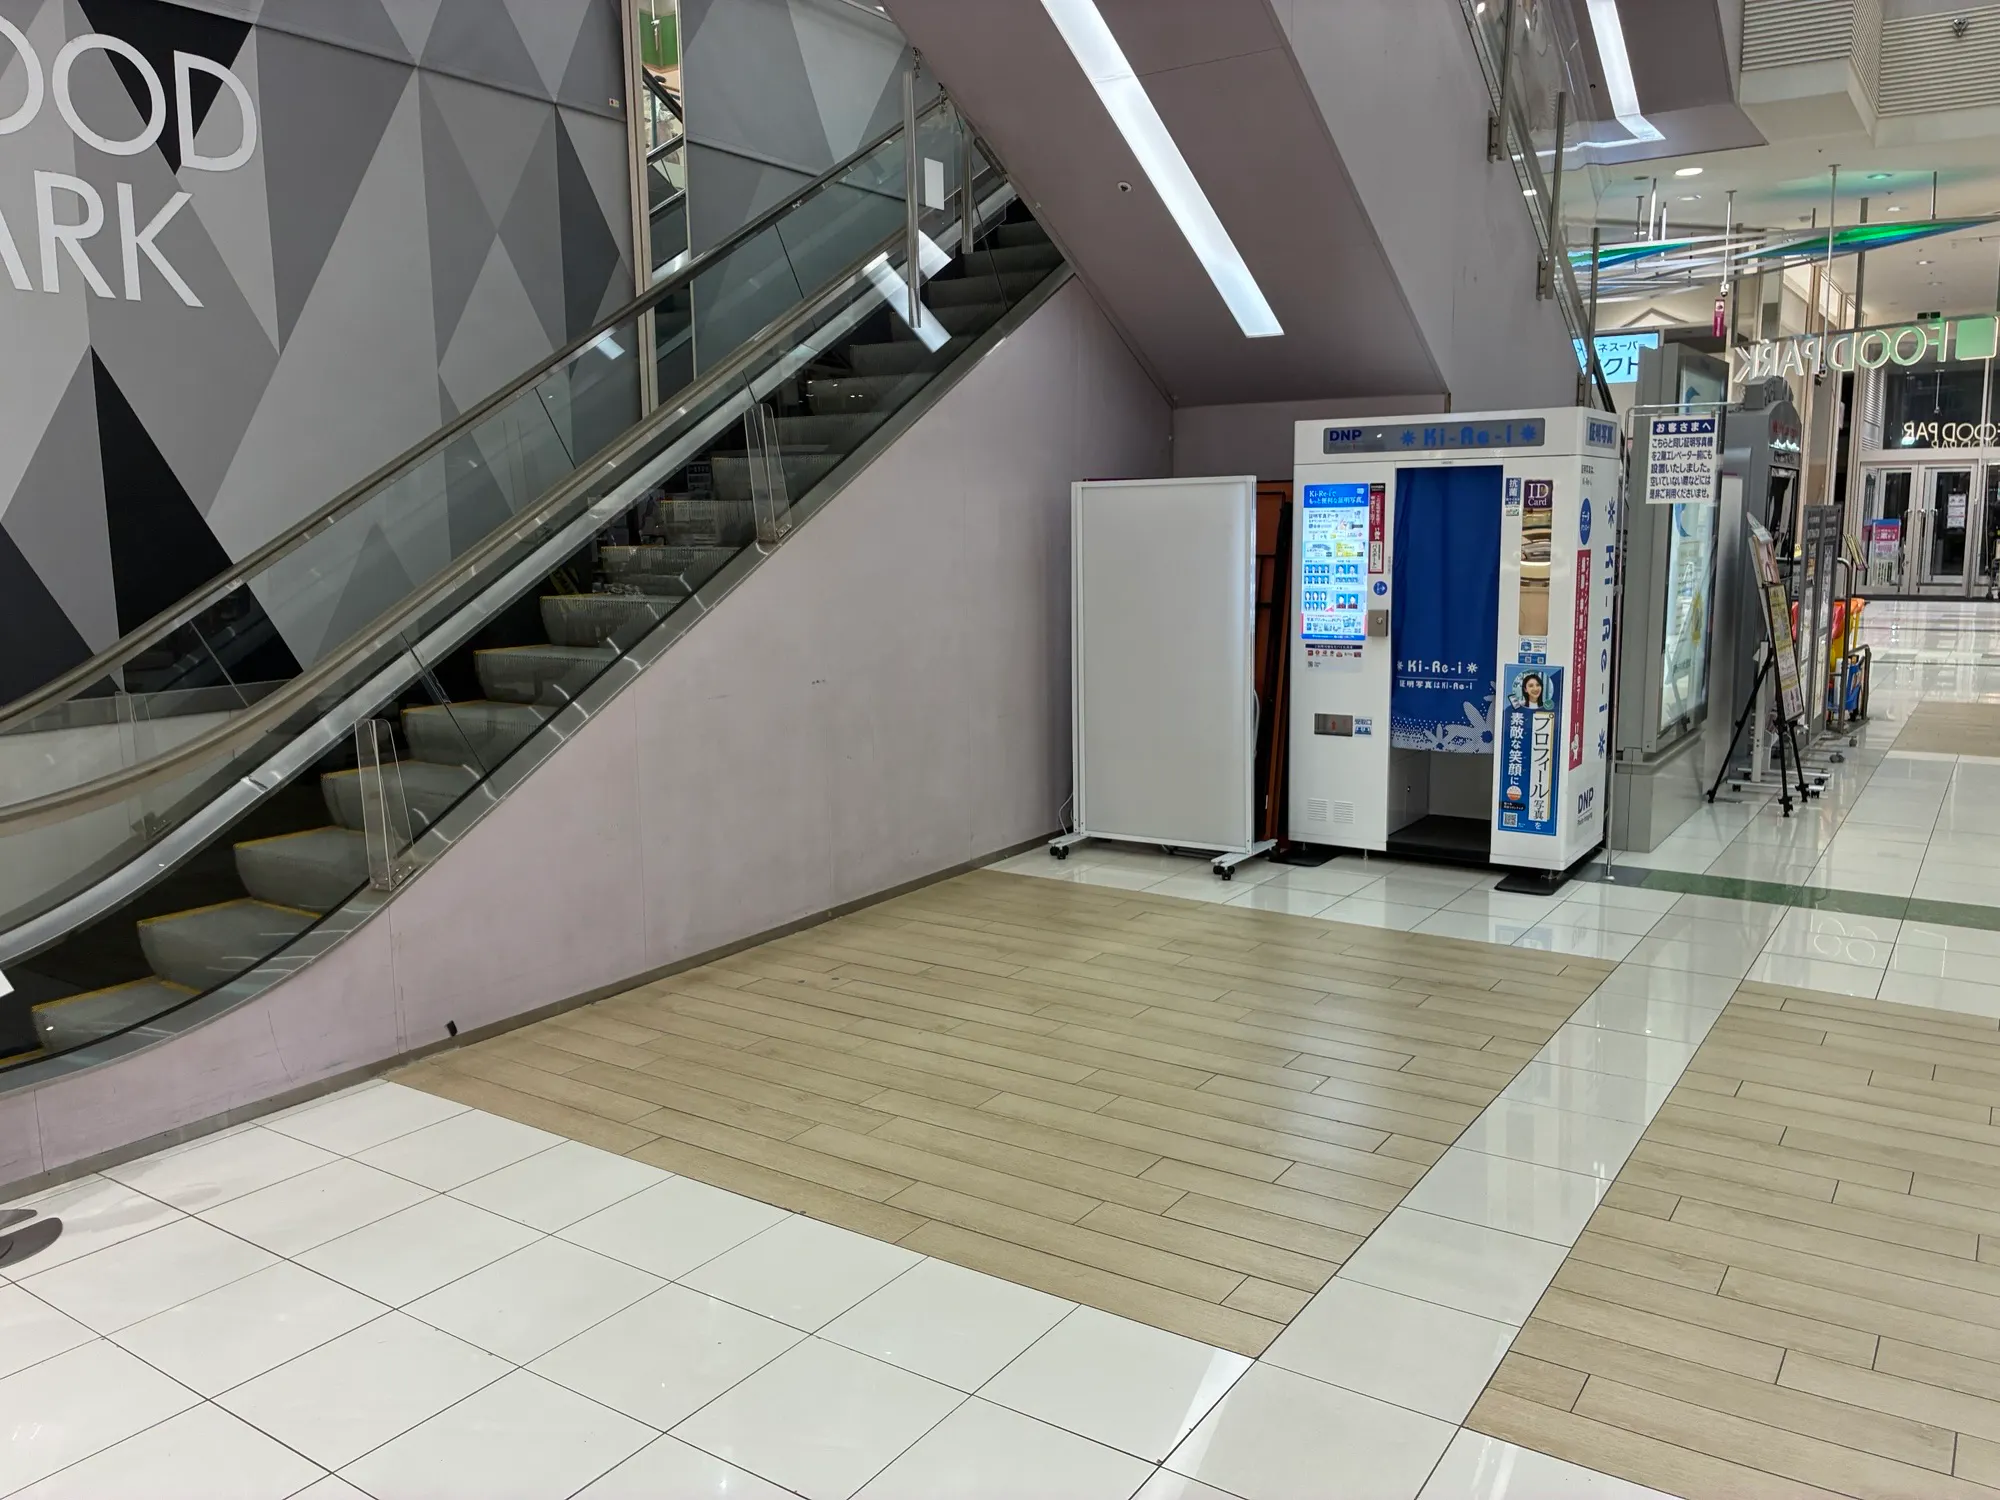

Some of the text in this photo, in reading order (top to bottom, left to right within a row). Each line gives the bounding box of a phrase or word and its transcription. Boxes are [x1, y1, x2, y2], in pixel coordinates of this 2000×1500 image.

[1656, 422, 1711, 433] お客さまへ
[1329, 429, 1362, 442] DNP
[1651, 463, 1710, 474] 設置いたしました。
[1528, 483, 1549, 498] ID
[1528, 498, 1547, 506] Card
[1407, 660, 1462, 674] Ki-Re-i
[1508, 712, 1525, 786] 素敵な笑顔に
[1578, 787, 1594, 814] DNP
